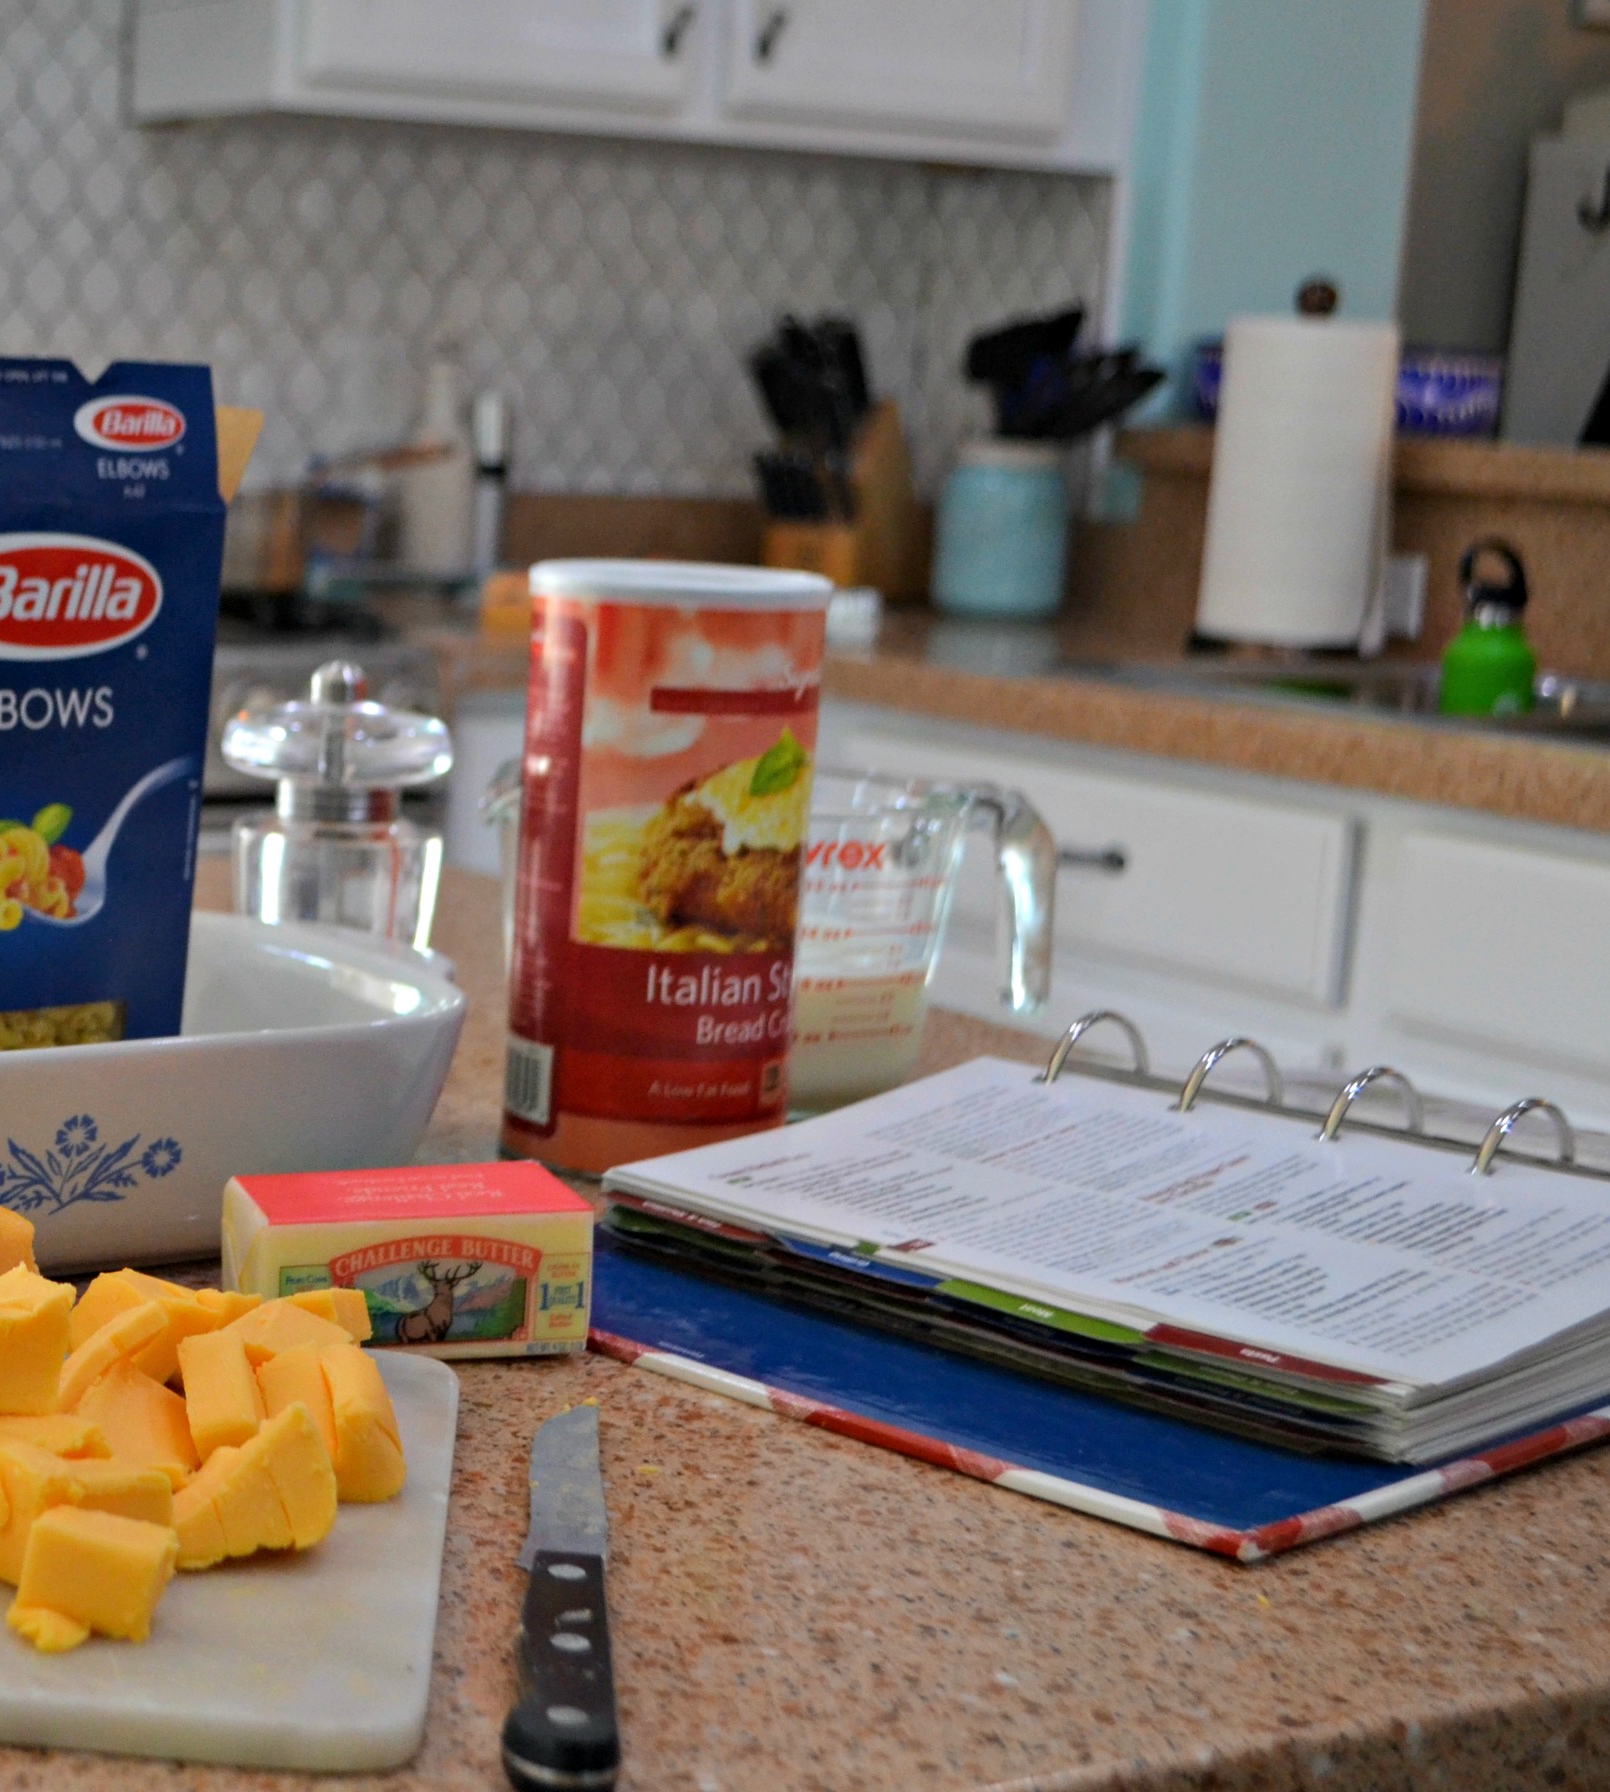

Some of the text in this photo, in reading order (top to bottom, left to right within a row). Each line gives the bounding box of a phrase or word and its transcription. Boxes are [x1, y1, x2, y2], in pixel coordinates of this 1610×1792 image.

[101, 408, 177, 436] Barilla
[96, 457, 170, 480] ELBOWS
[646, 963, 763, 1006] Italian
[695, 1010, 767, 1045] Bread
[335, 1236, 535, 1278] CHALLENGE BUTTER
